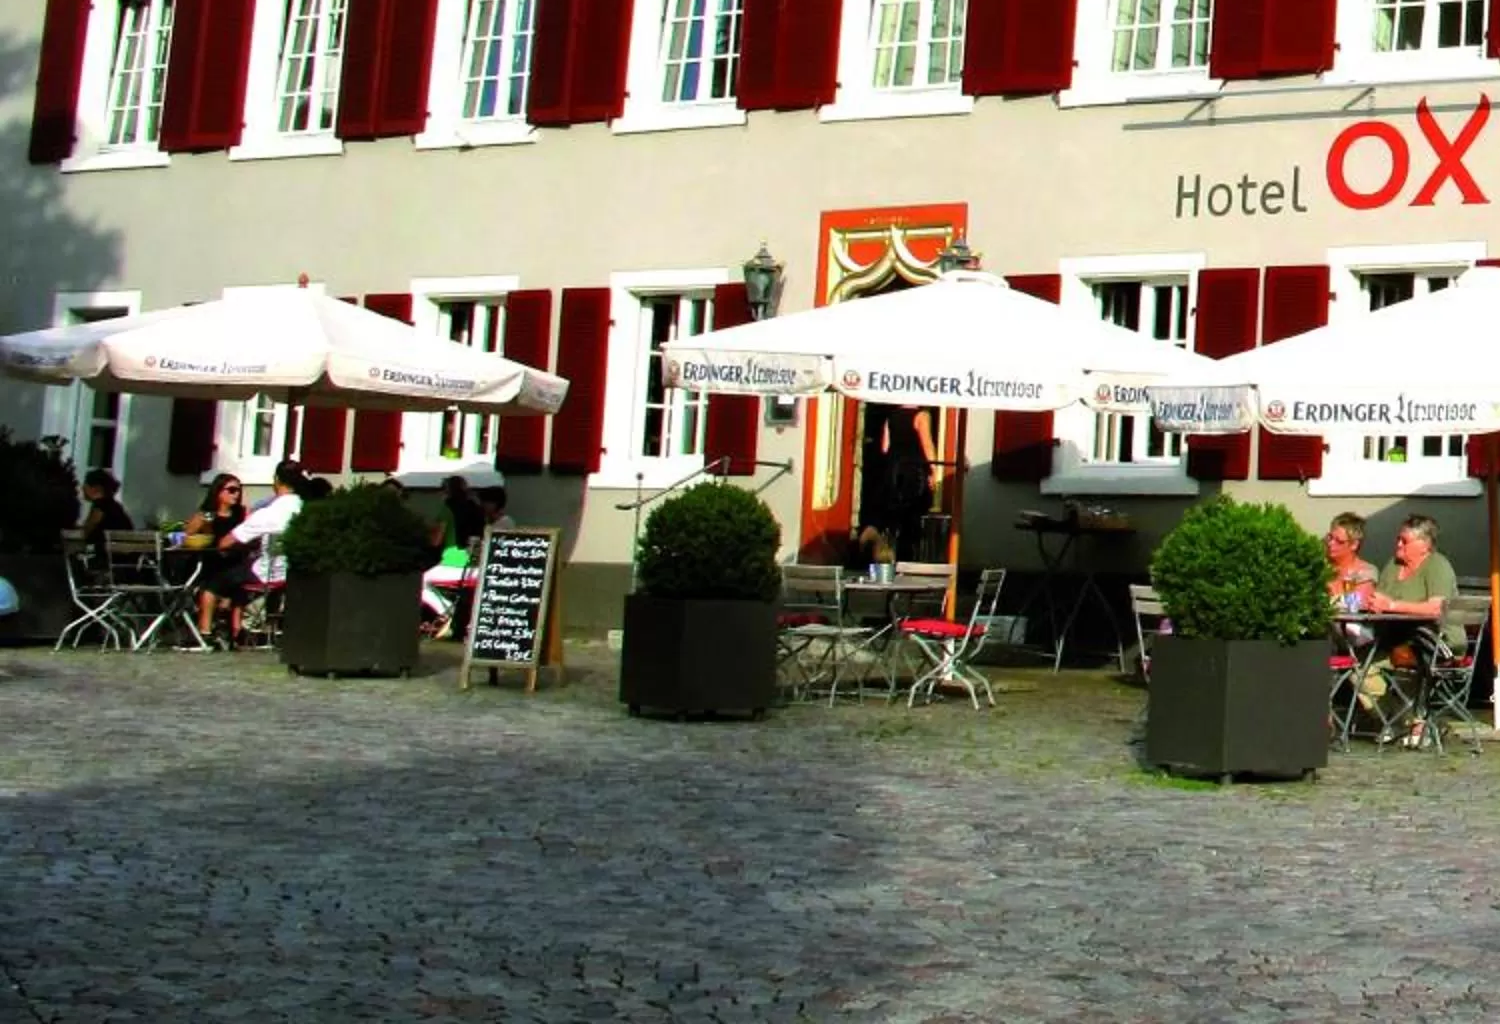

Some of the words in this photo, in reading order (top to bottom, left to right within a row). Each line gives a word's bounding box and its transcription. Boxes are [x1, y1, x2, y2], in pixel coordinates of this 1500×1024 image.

[1175, 166, 1307, 218] Hotel
[1325, 91, 1491, 210] OX
[683, 361, 744, 385] ERDINGER
[868, 371, 963, 397] ERDINGER
[1113, 385, 1150, 404] ERDIN
[1292, 400, 1392, 424] ERDINGER
